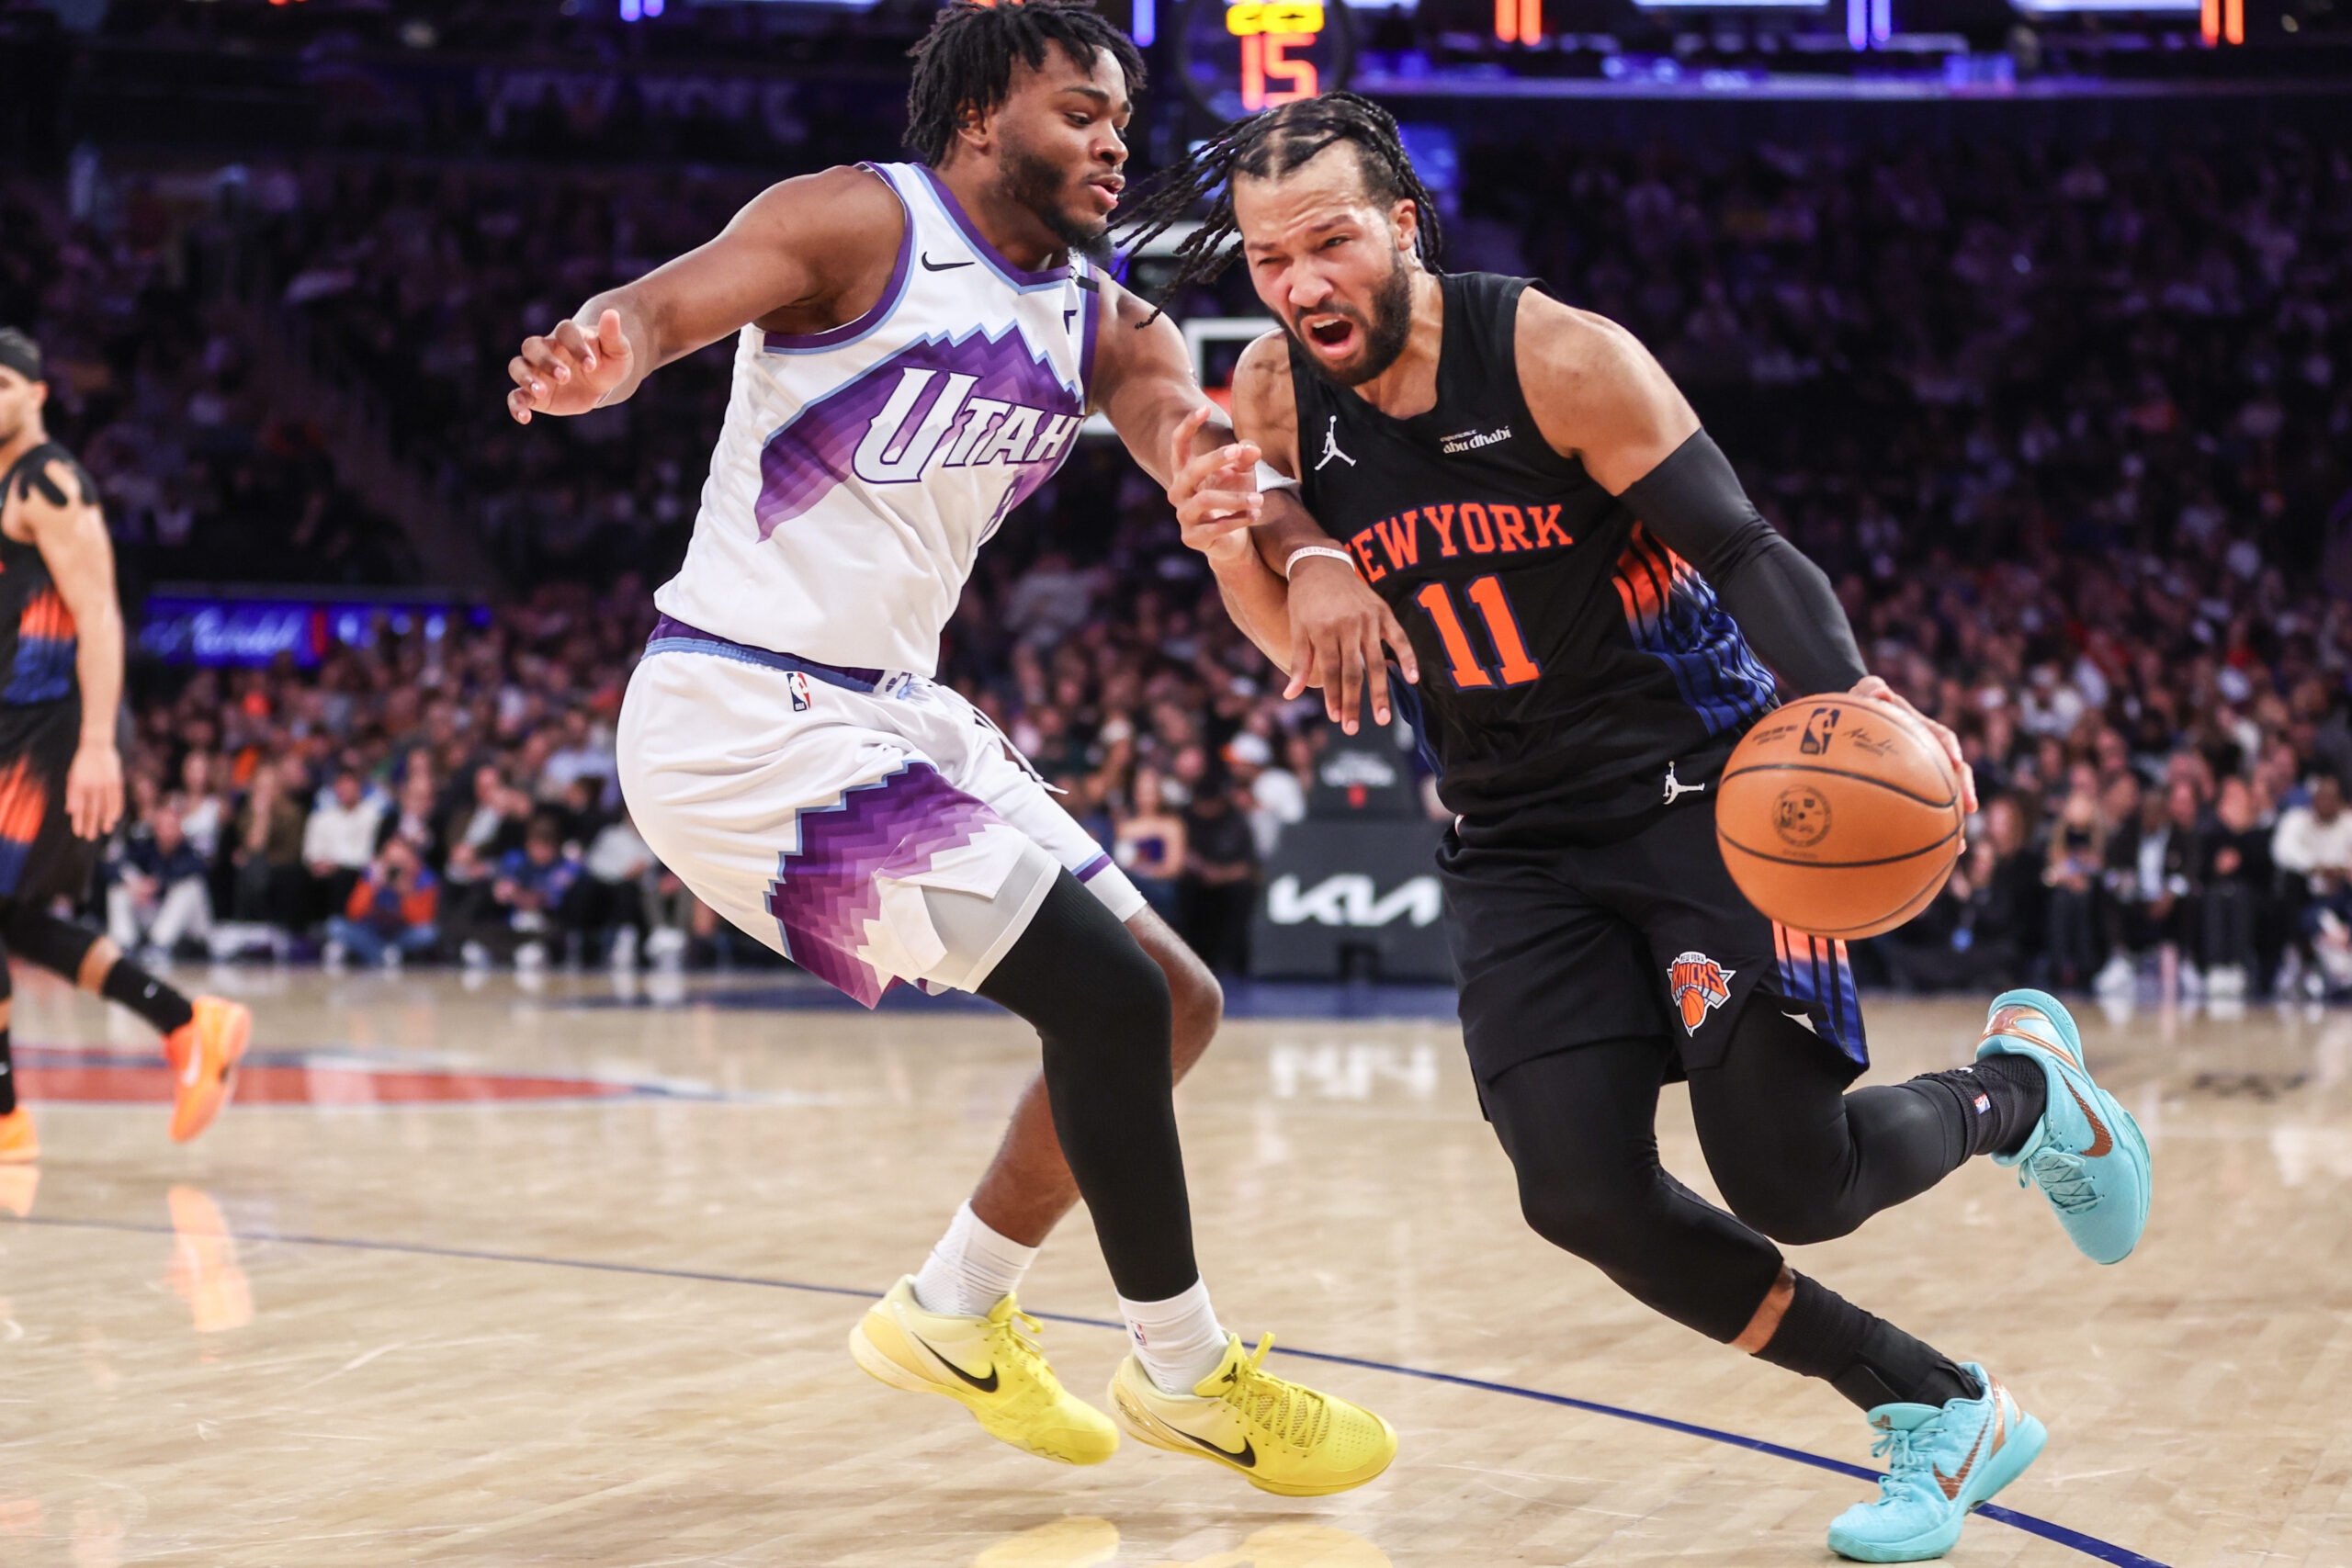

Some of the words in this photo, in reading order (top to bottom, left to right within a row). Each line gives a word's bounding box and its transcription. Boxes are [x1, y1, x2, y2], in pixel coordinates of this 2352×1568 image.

[1241, 31, 1318, 111] 15
[1443, 441, 1469, 454] abu
[1470, 425, 1512, 449] dhabi
[1344, 509, 1419, 585] EW
[1422, 502, 1574, 558] YORK
[1414, 573, 1543, 691] 11
[1672, 962, 1727, 998] KNICKS
